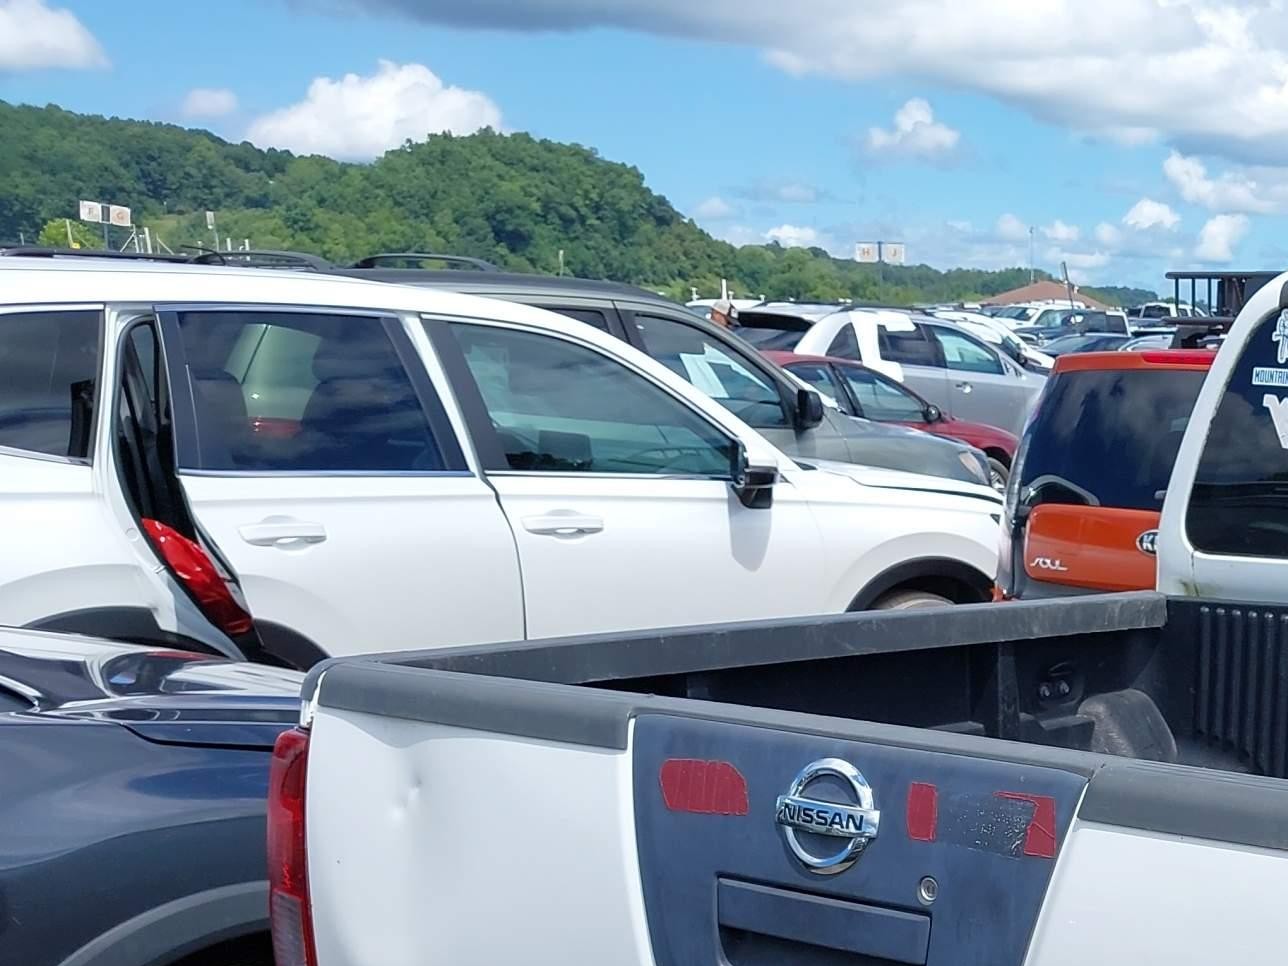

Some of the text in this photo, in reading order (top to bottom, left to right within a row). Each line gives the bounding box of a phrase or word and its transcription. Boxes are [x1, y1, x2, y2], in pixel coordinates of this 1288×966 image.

[1142, 534, 1159, 551] KI
[1030, 557, 1068, 571] SOUL
[783, 802, 864, 831] NISSAN
